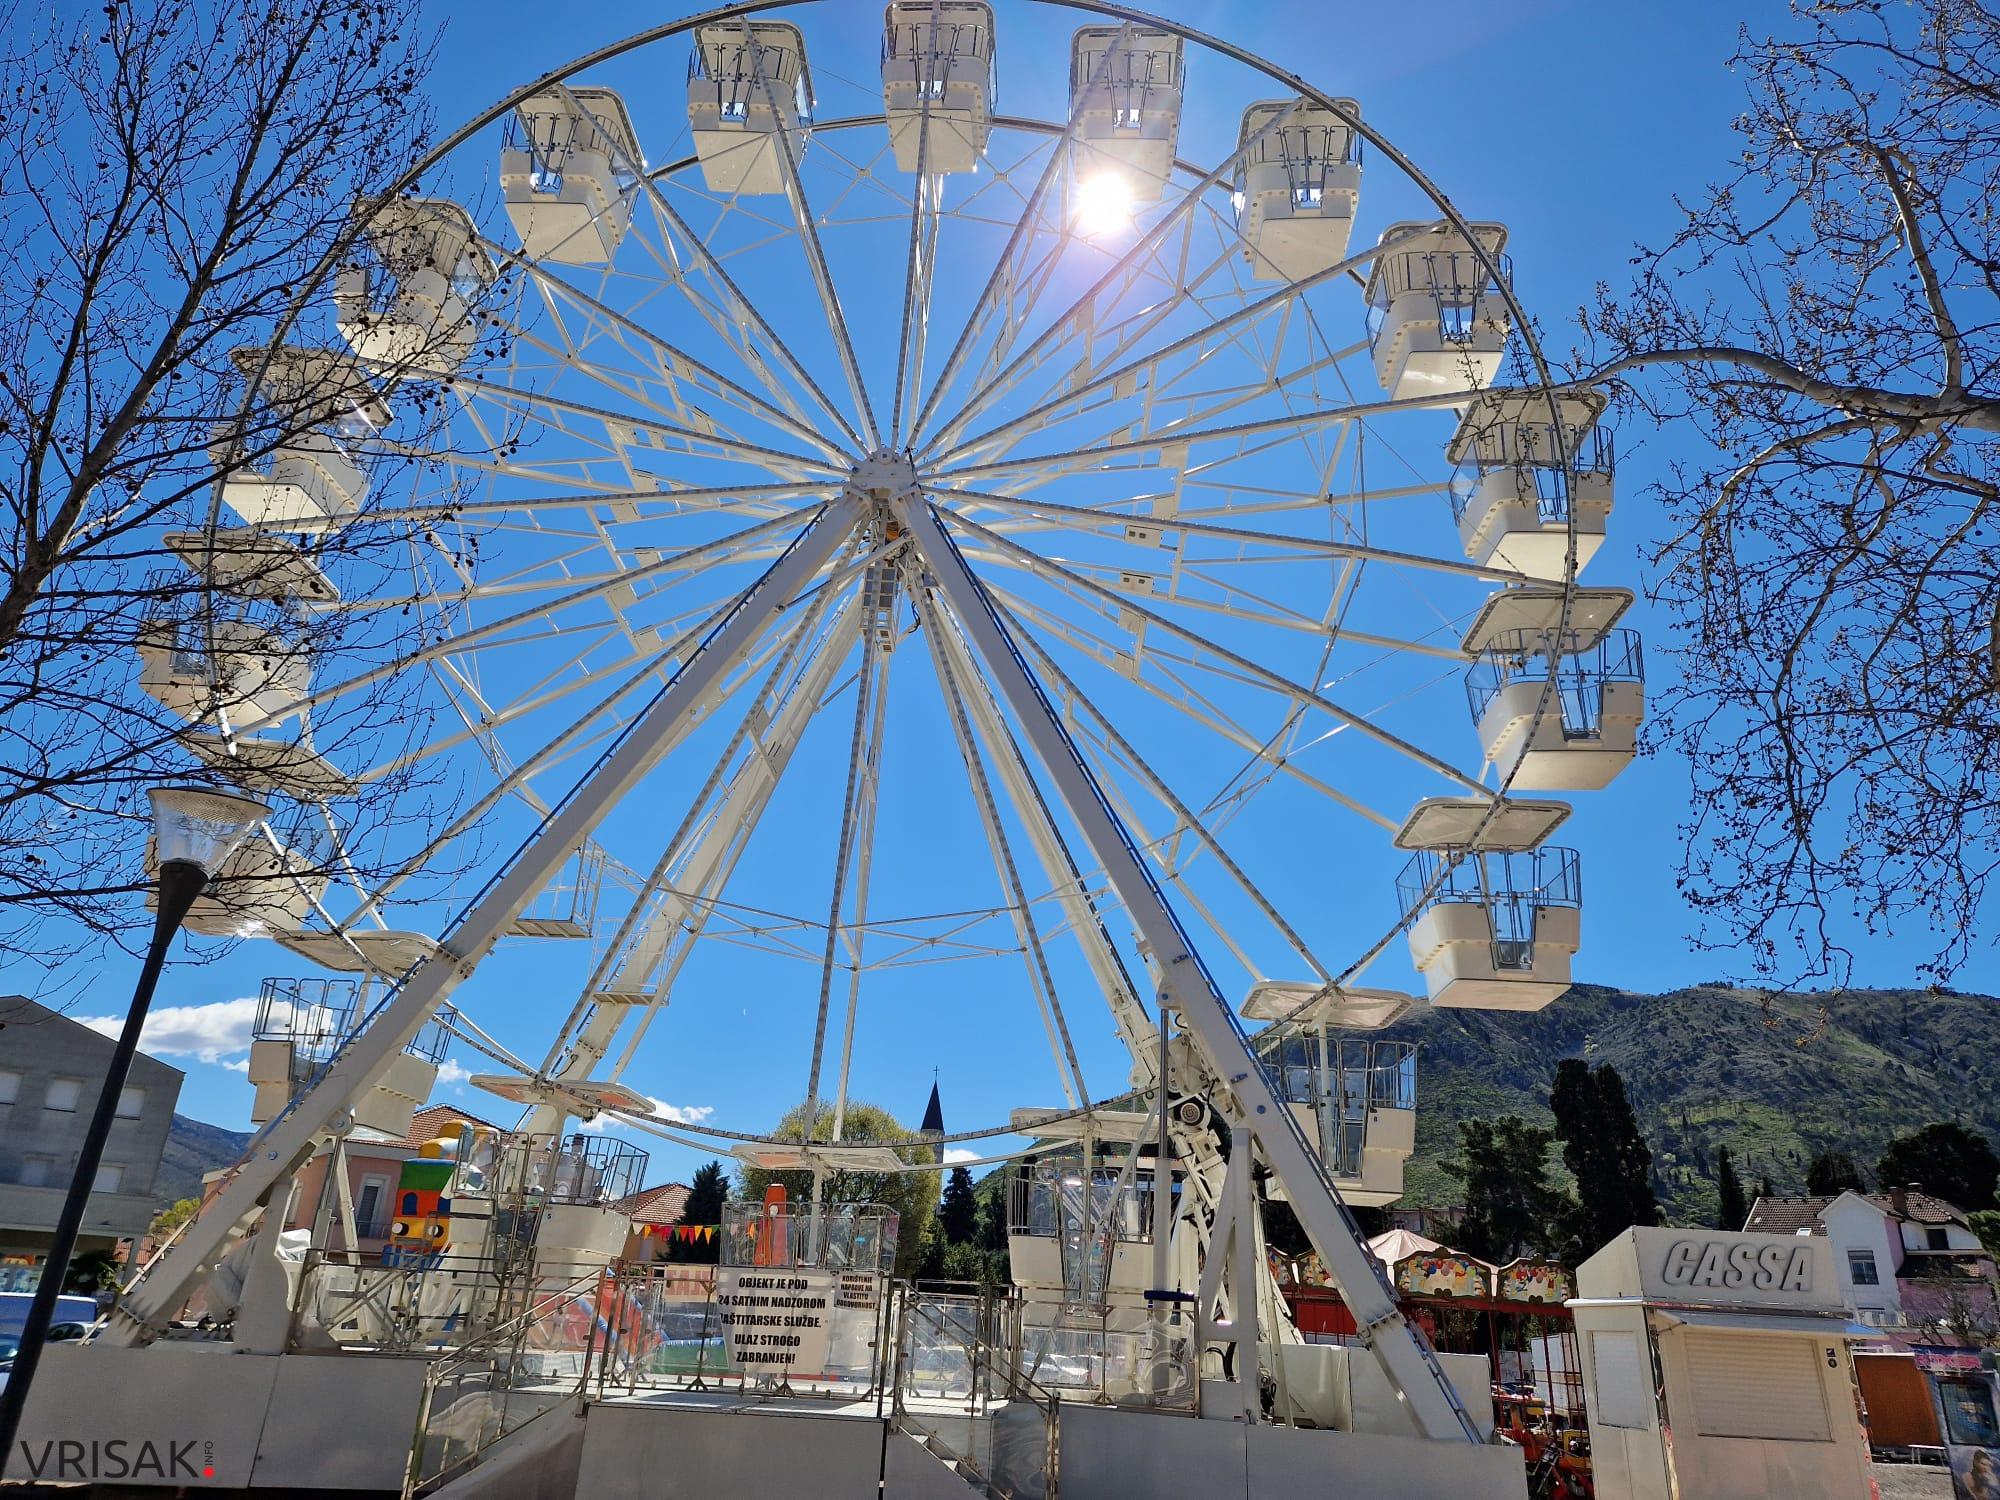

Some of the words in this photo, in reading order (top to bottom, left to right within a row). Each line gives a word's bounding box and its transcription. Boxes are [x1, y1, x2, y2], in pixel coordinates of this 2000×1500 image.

[1663, 1240, 1813, 1291] CASSA
[738, 1277, 775, 1289] OBJEKT
[776, 1278, 786, 1289] JE
[787, 1279, 808, 1290] POD
[718, 1294, 730, 1306] 24
[731, 1295, 769, 1307] SATNIM
[771, 1296, 826, 1309] NADZOROM
[720, 1312, 782, 1326] AŠTITARSKE
[734, 1333, 759, 1345] ULAZ
[760, 1334, 801, 1347] STROGO
[736, 1351, 796, 1364] ZABRANJEN!
